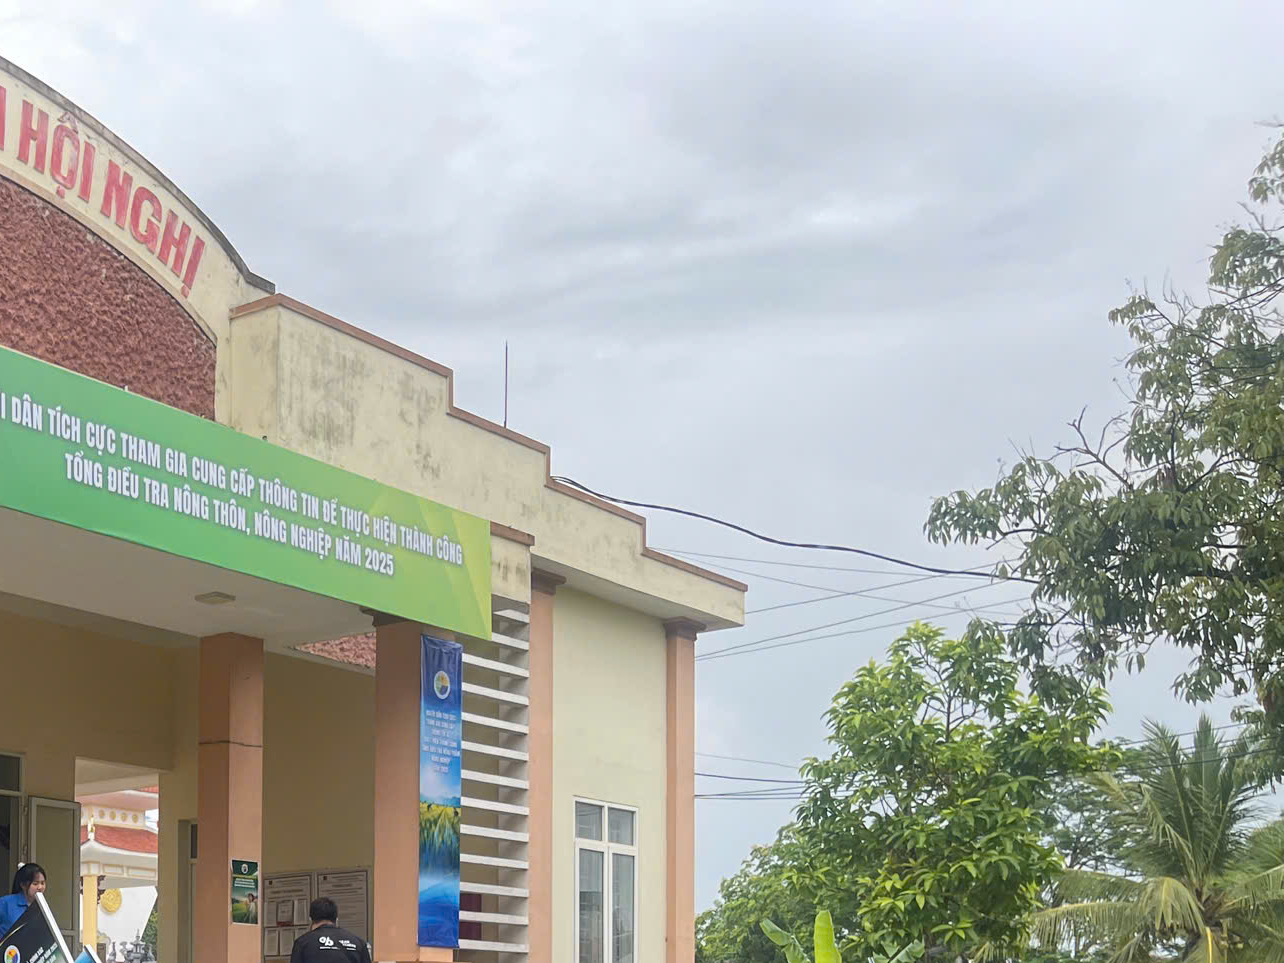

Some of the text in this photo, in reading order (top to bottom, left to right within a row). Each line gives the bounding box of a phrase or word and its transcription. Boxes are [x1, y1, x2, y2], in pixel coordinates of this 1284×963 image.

[17, 100, 97, 202] HỘI
[100, 159, 206, 299] NGHỊ
[11, 393, 43, 431] DÂN
[48, 405, 81, 443] TÍCH
[86, 421, 116, 455] CỰC
[120, 432, 161, 469] THAM
[166, 448, 188, 477] GIA
[192, 456, 226, 489] CUNG
[230, 468, 255, 498] CẤP
[259, 477, 298, 512] THÔNG
[301, 492, 319, 520] TIN
[322, 498, 338, 525] ĐỂ
[340, 506, 370, 537] THỰC
[373, 515, 397, 546] HIỆN
[400, 525, 433, 556] THÀNH
[436, 535, 463, 565] CÔNG
[65, 450, 394, 576] TỔNG ĐIỀU TRA NÔNG THÔN, NÔNG NGHIỆP NĂM 2025
